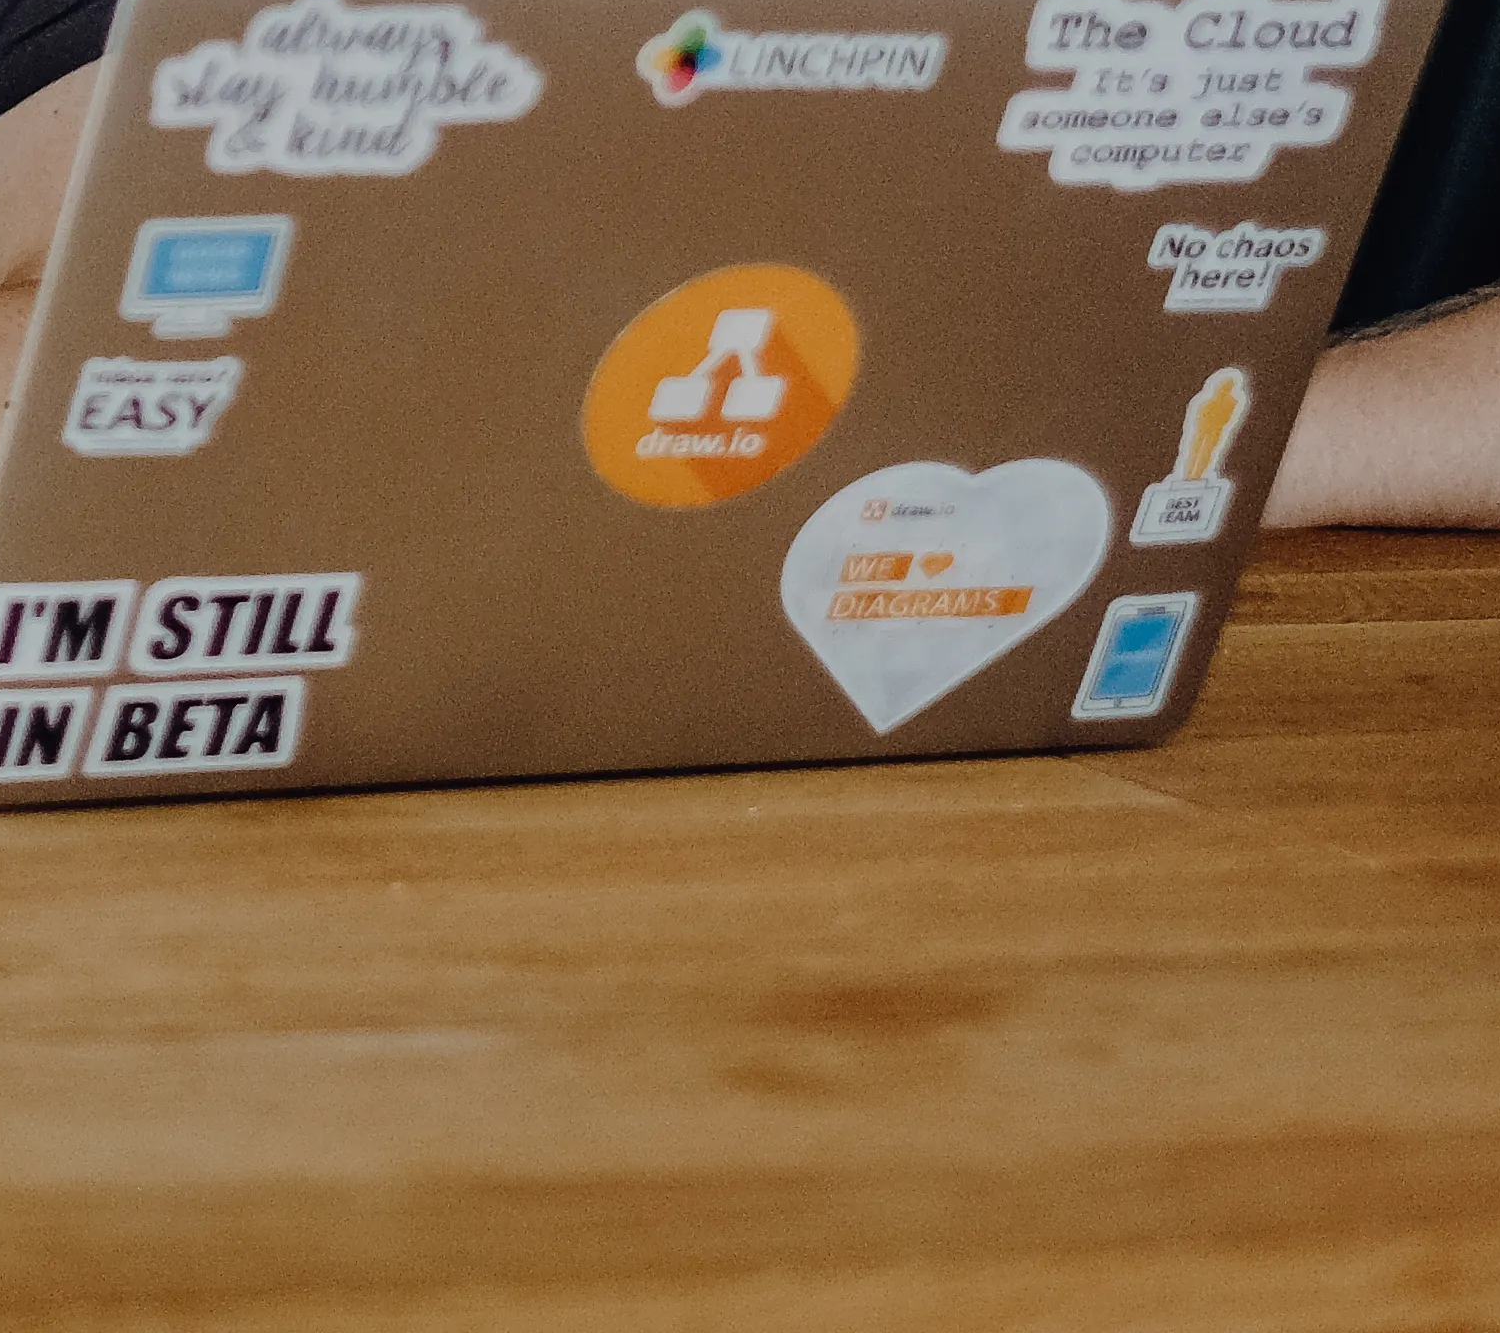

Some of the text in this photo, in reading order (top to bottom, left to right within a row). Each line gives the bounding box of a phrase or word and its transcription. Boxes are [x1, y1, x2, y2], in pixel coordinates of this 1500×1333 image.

[1050, 9, 1359, 50] The Cloud
[728, 43, 931, 77] LINCHPIN
[176, 53, 508, 123] stay humble
[1094, 66, 1284, 99] It's just
[286, 99, 413, 157] kind
[1020, 101, 1325, 131] someone else's
[1069, 140, 1253, 171] computer
[1157, 232, 1312, 259] No chaos
[1179, 260, 1272, 290] here!
[79, 391, 216, 430] EASY
[635, 427, 766, 458] draw.io
[1159, 510, 1201, 524] TEAM
[1165, 496, 1203, 510] BEST
[848, 555, 898, 580] WE
[832, 588, 1001, 617] DIAGRAMS
[150, 588, 341, 660] STILL
[101, 694, 287, 762] BETA
